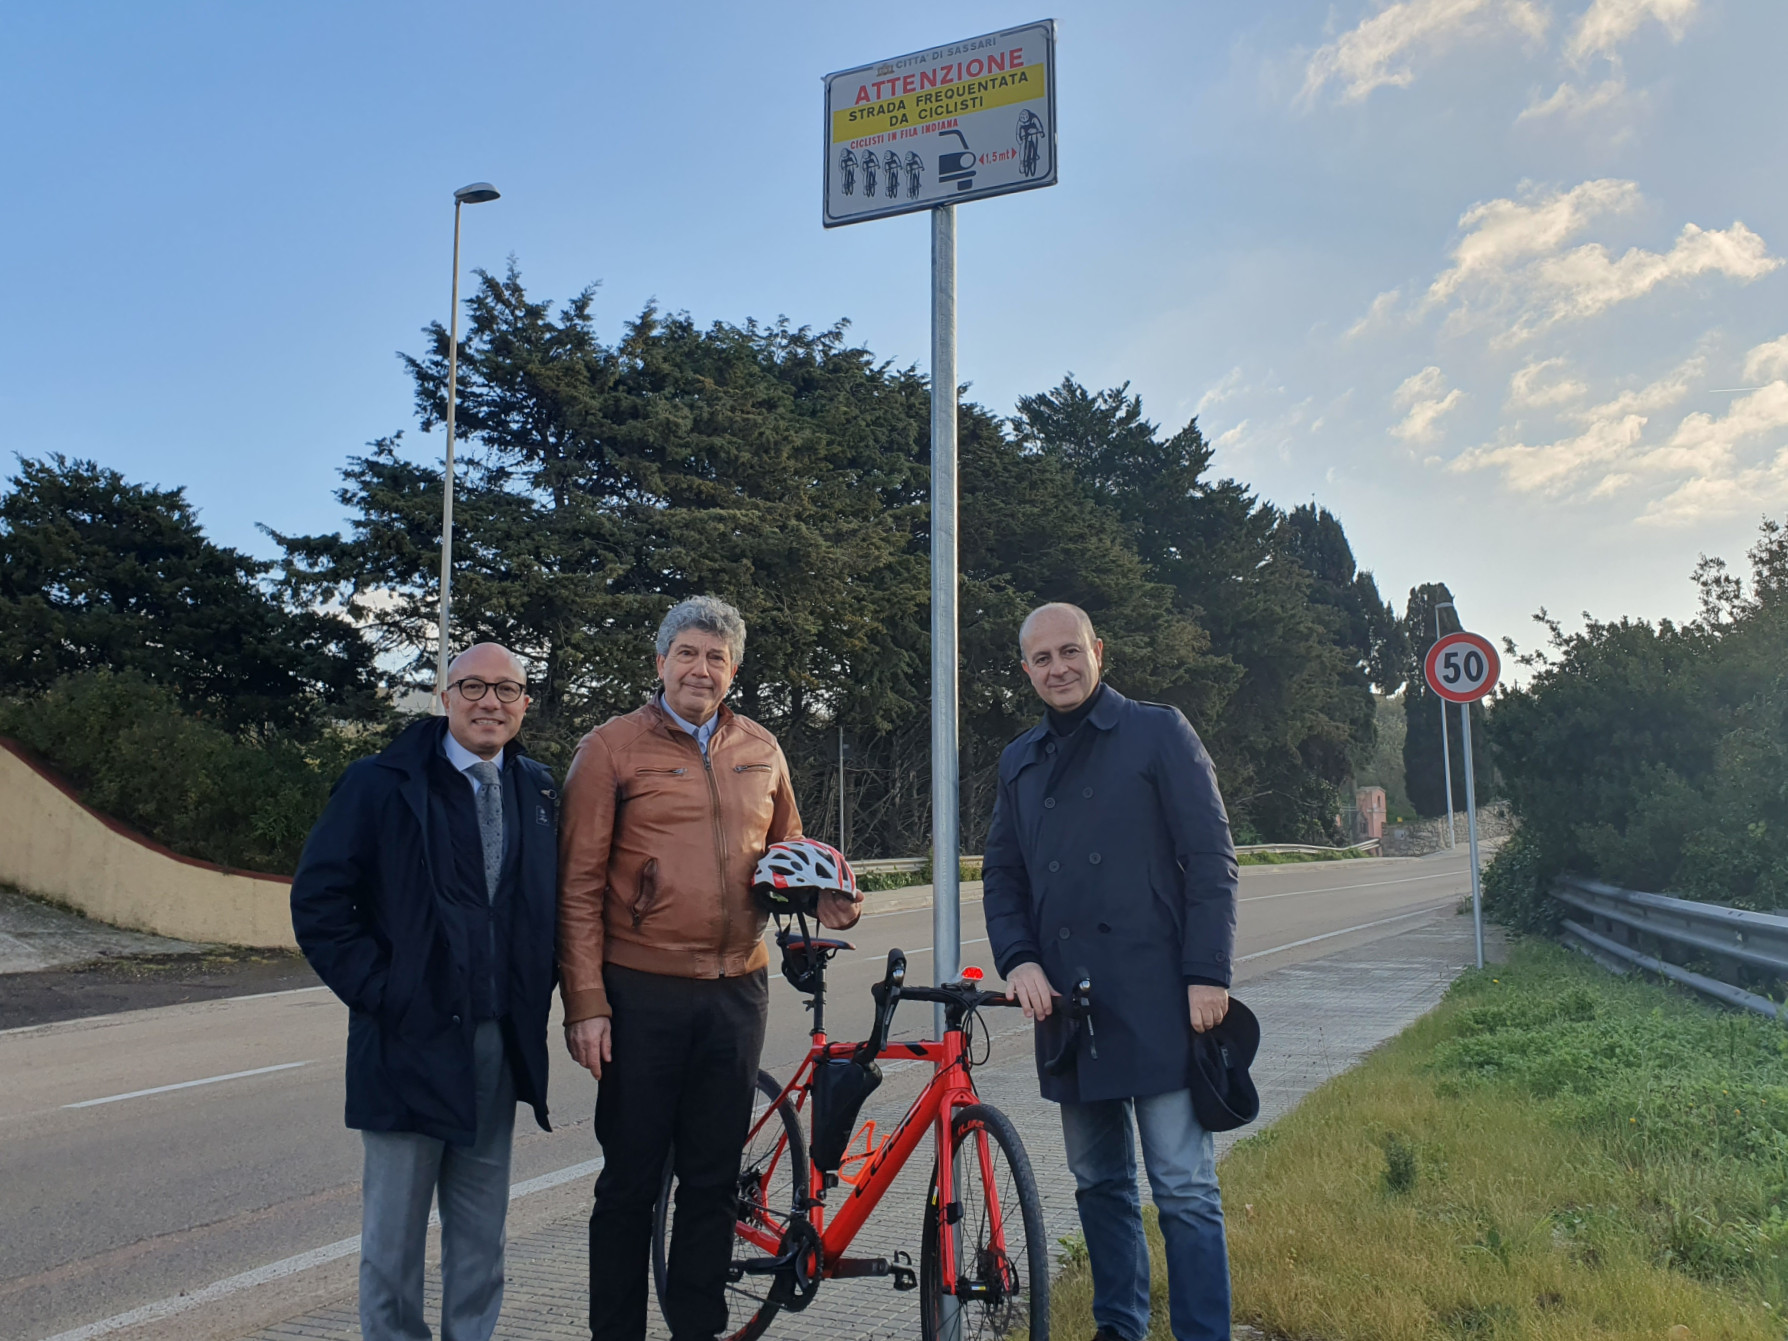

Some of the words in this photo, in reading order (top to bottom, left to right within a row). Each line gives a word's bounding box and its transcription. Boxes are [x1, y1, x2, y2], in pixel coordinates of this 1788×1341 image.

[932, 50, 943, 61] DI
[947, 38, 996, 56] SASSARI
[854, 47, 1025, 105] ATTENZIONE
[849, 100, 906, 122] STRADA
[916, 71, 1029, 107] FREQUENTATA
[889, 115, 908, 126] DA
[918, 96, 983, 120] CICLISTI
[850, 134, 884, 149] CICLISTI
[887, 131, 896, 141] IN
[900, 125, 918, 139] FILA
[921, 118, 959, 135] INDIANA
[1443, 651, 1483, 683] 50
